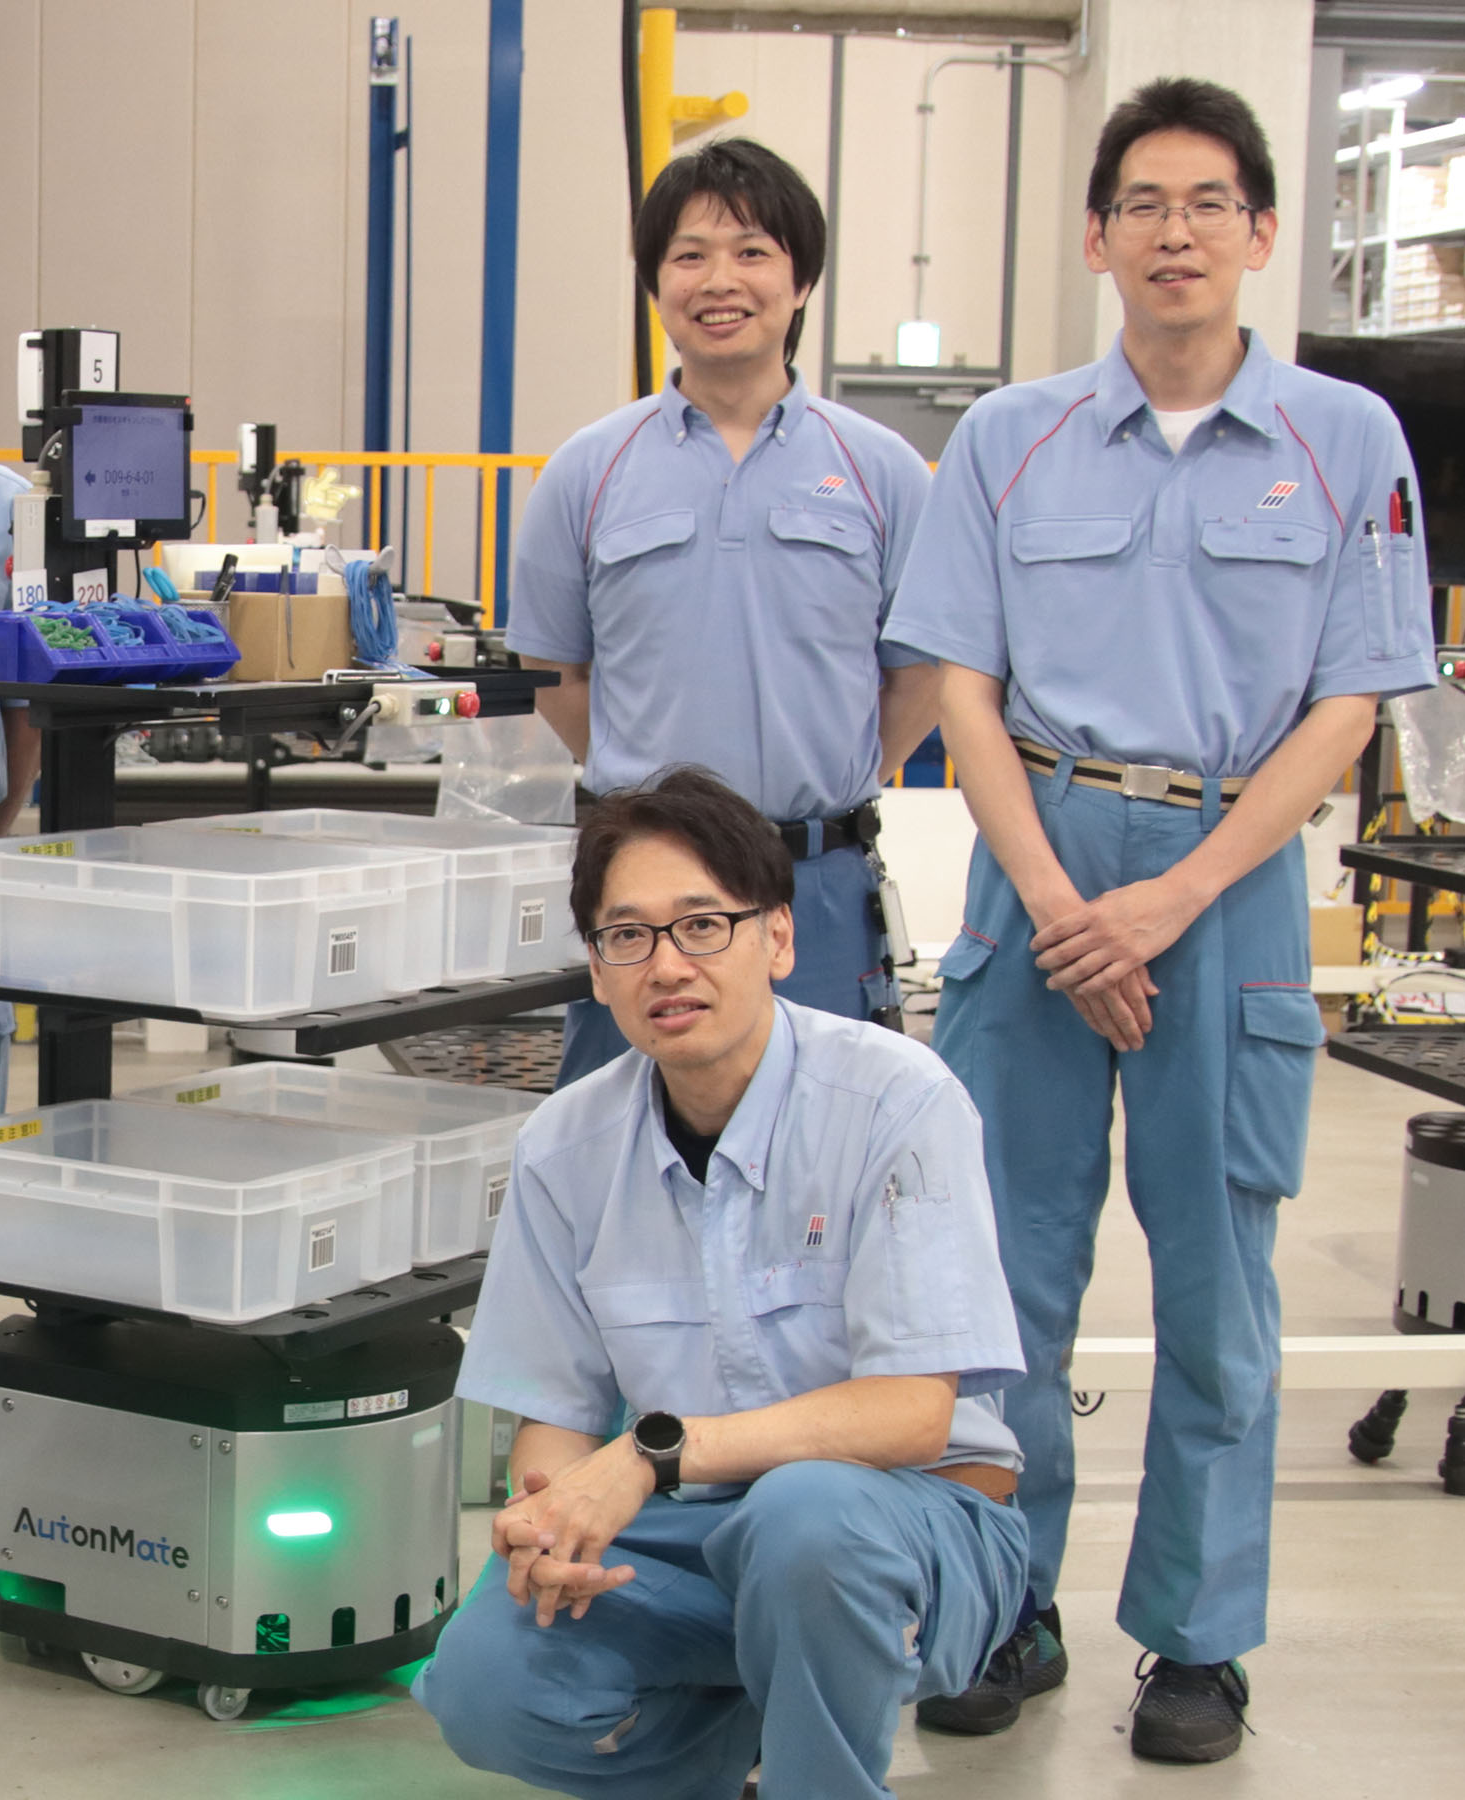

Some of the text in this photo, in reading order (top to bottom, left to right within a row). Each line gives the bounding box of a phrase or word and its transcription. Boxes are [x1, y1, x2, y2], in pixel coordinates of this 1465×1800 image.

[93, 359, 103, 383] 5
[17, 584, 45, 606] 180
[77, 583, 104, 606] 220
[12, 1506, 190, 1569] AutonMate
